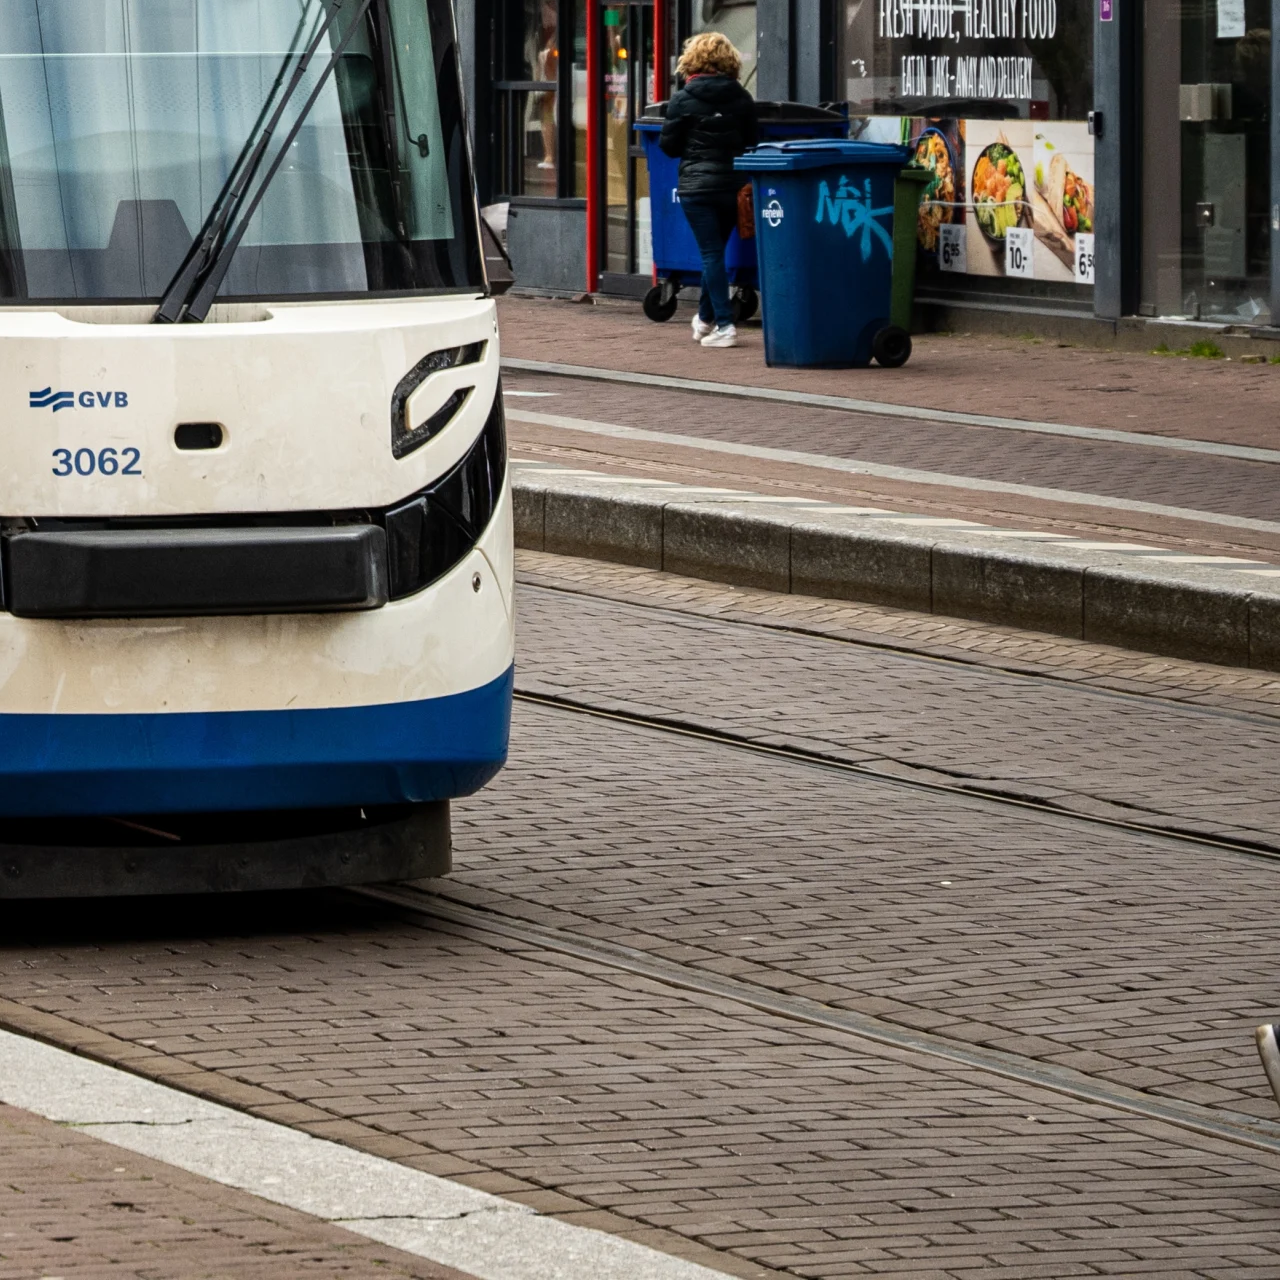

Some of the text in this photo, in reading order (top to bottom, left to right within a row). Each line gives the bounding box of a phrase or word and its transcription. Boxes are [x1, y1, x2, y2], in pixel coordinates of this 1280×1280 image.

[978, 56, 997, 98] AND
[997, 56, 1032, 99] DELIVERY
[942, 242, 960, 266] 6,95
[78, 391, 129, 408] GVB
[52, 447, 142, 476] 3062
